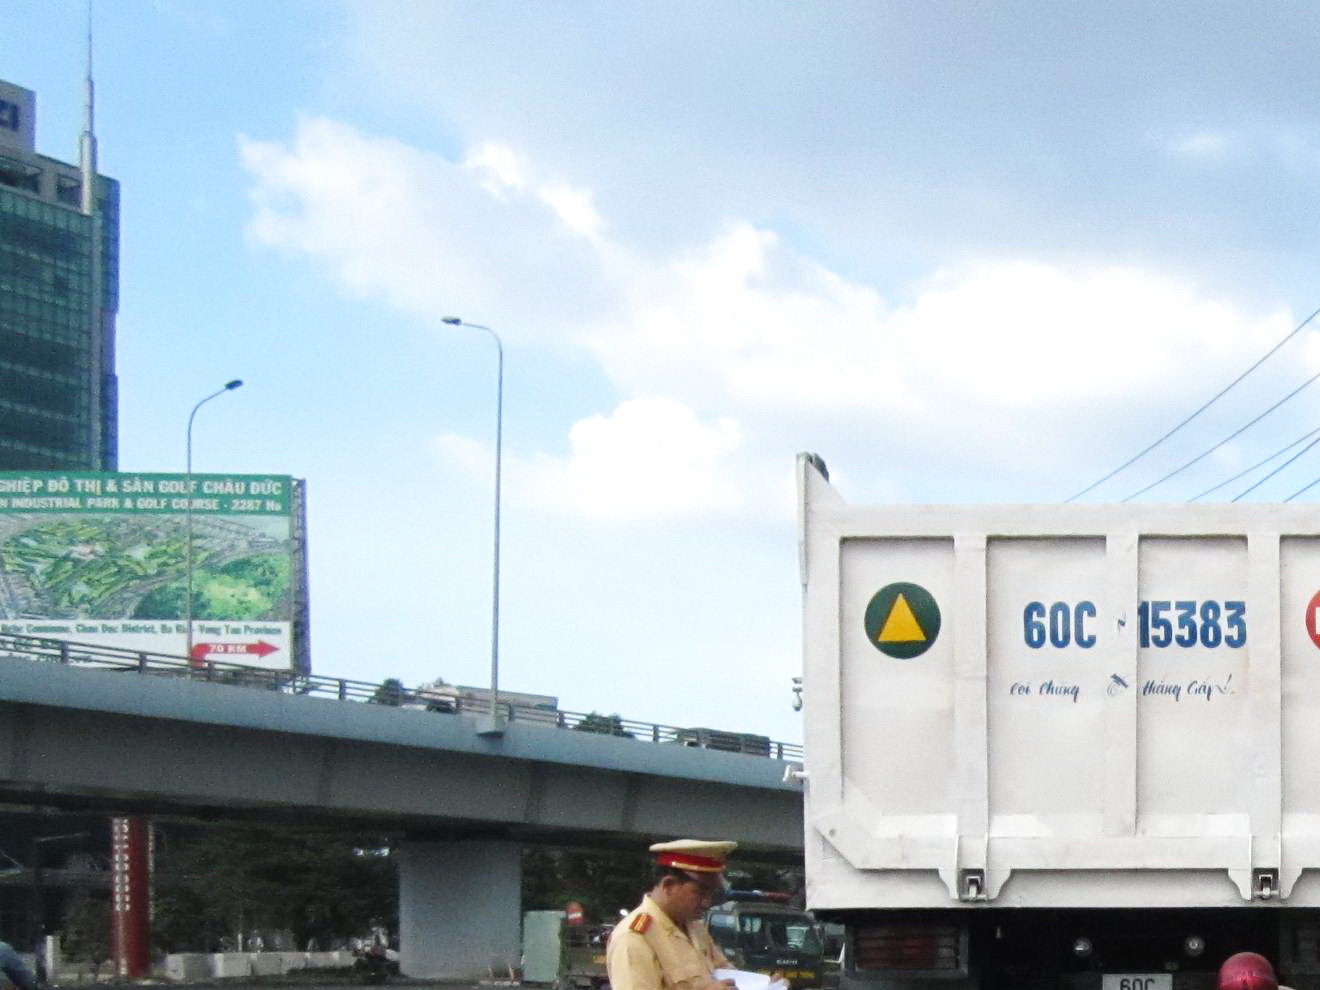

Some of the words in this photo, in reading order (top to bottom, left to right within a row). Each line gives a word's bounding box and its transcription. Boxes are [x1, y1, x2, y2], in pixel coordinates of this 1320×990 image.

[159, 480, 198, 494] GOLF
[1023, 601, 1097, 649] 60C
[1137, 600, 1247, 649] 15383
